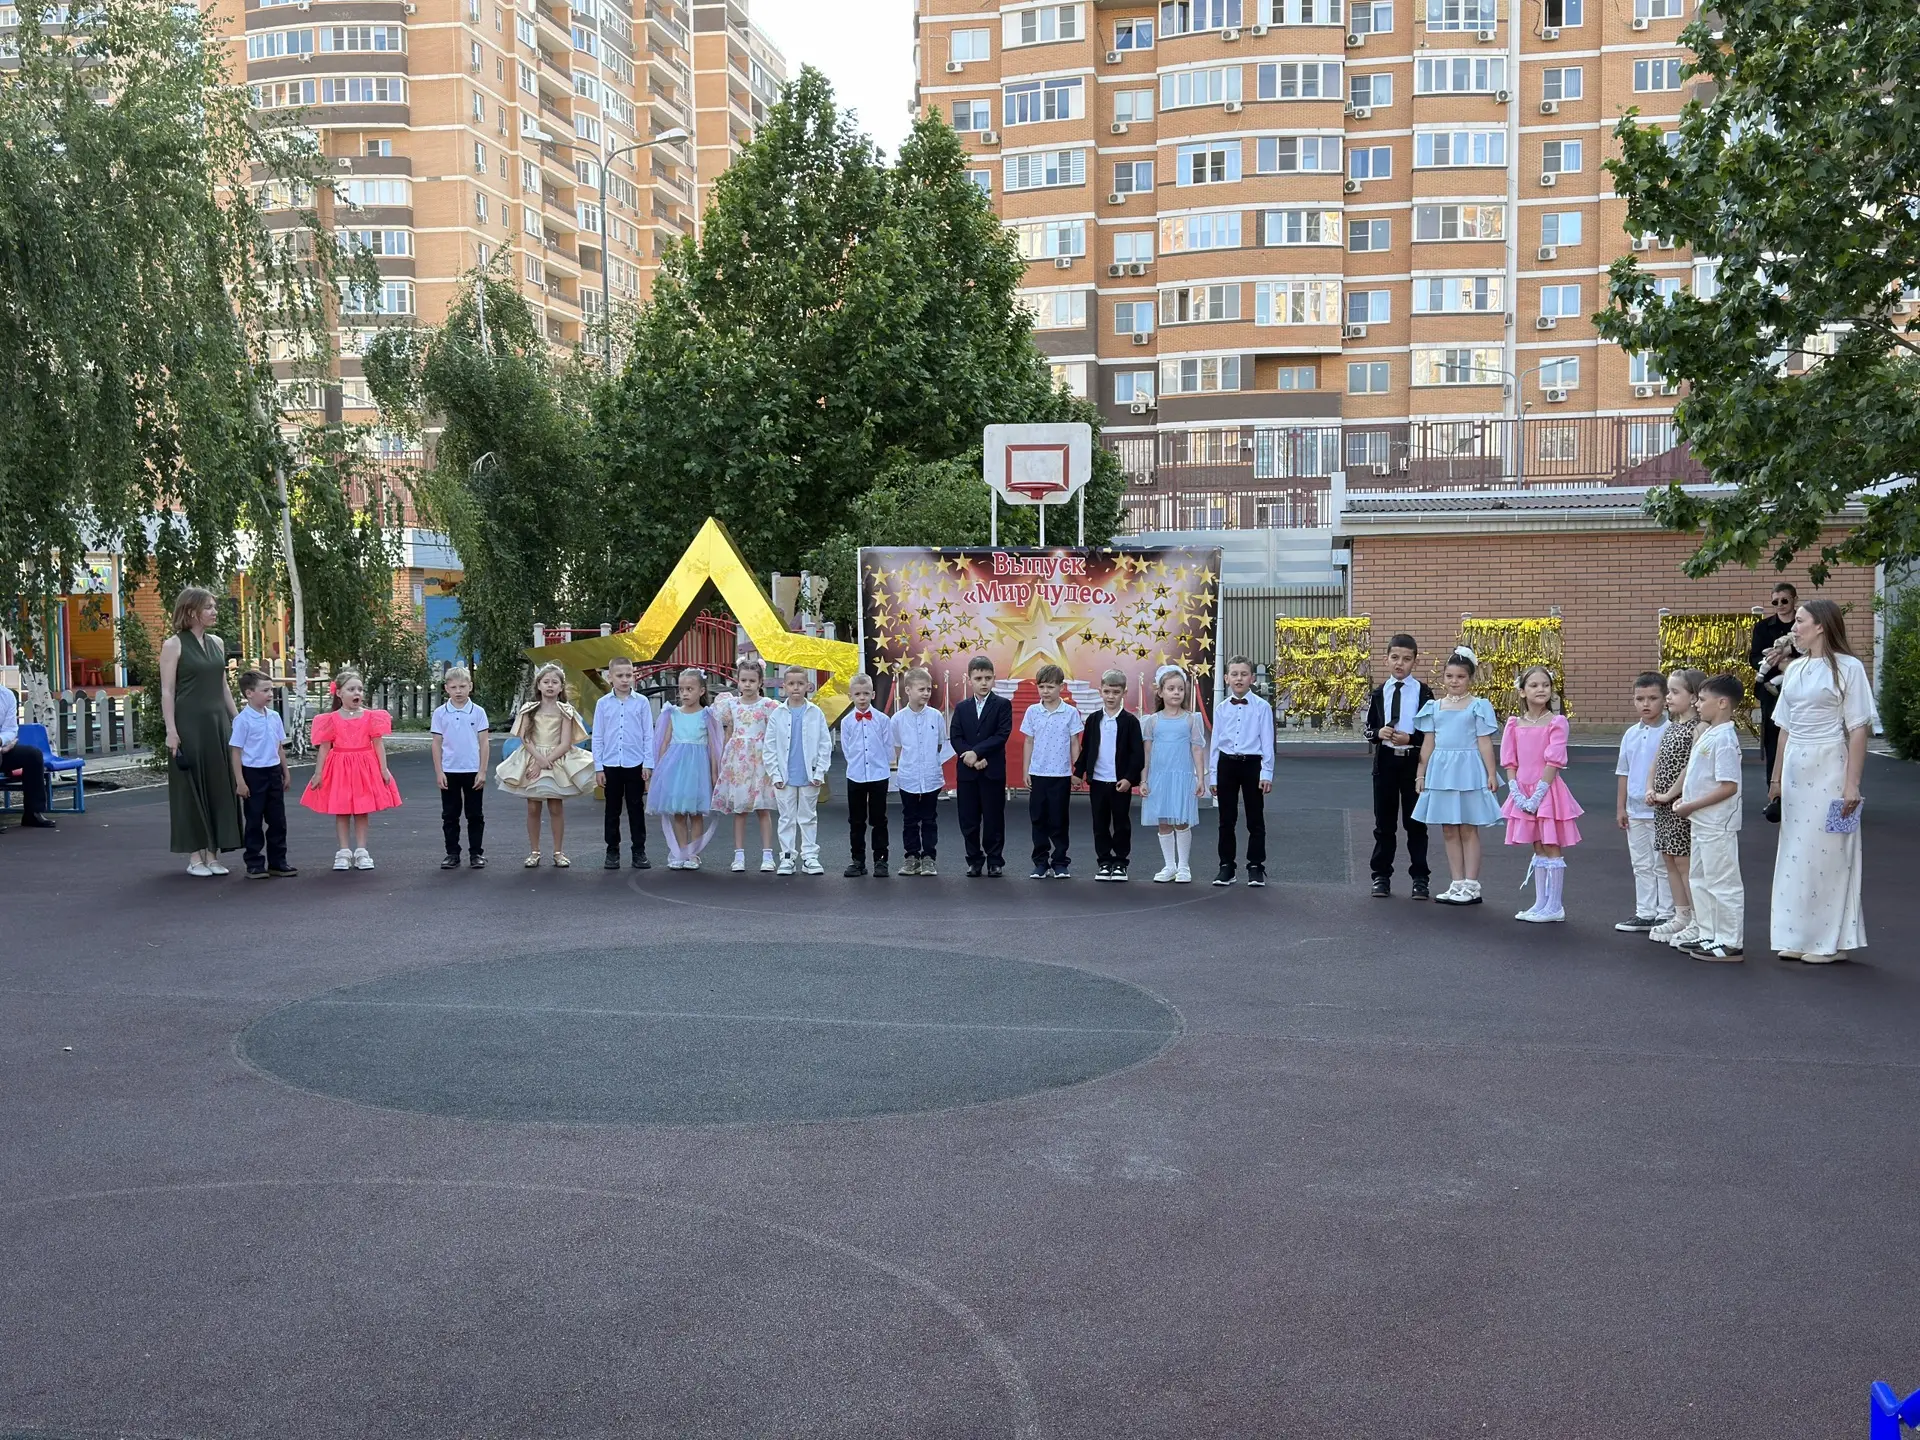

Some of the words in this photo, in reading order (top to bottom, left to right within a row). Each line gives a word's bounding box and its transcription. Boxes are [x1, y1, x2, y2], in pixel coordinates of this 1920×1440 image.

[992, 552, 1086, 580] Выпуск
[963, 580, 1031, 607] «Мир
[1036, 582, 1117, 607] чудес»
